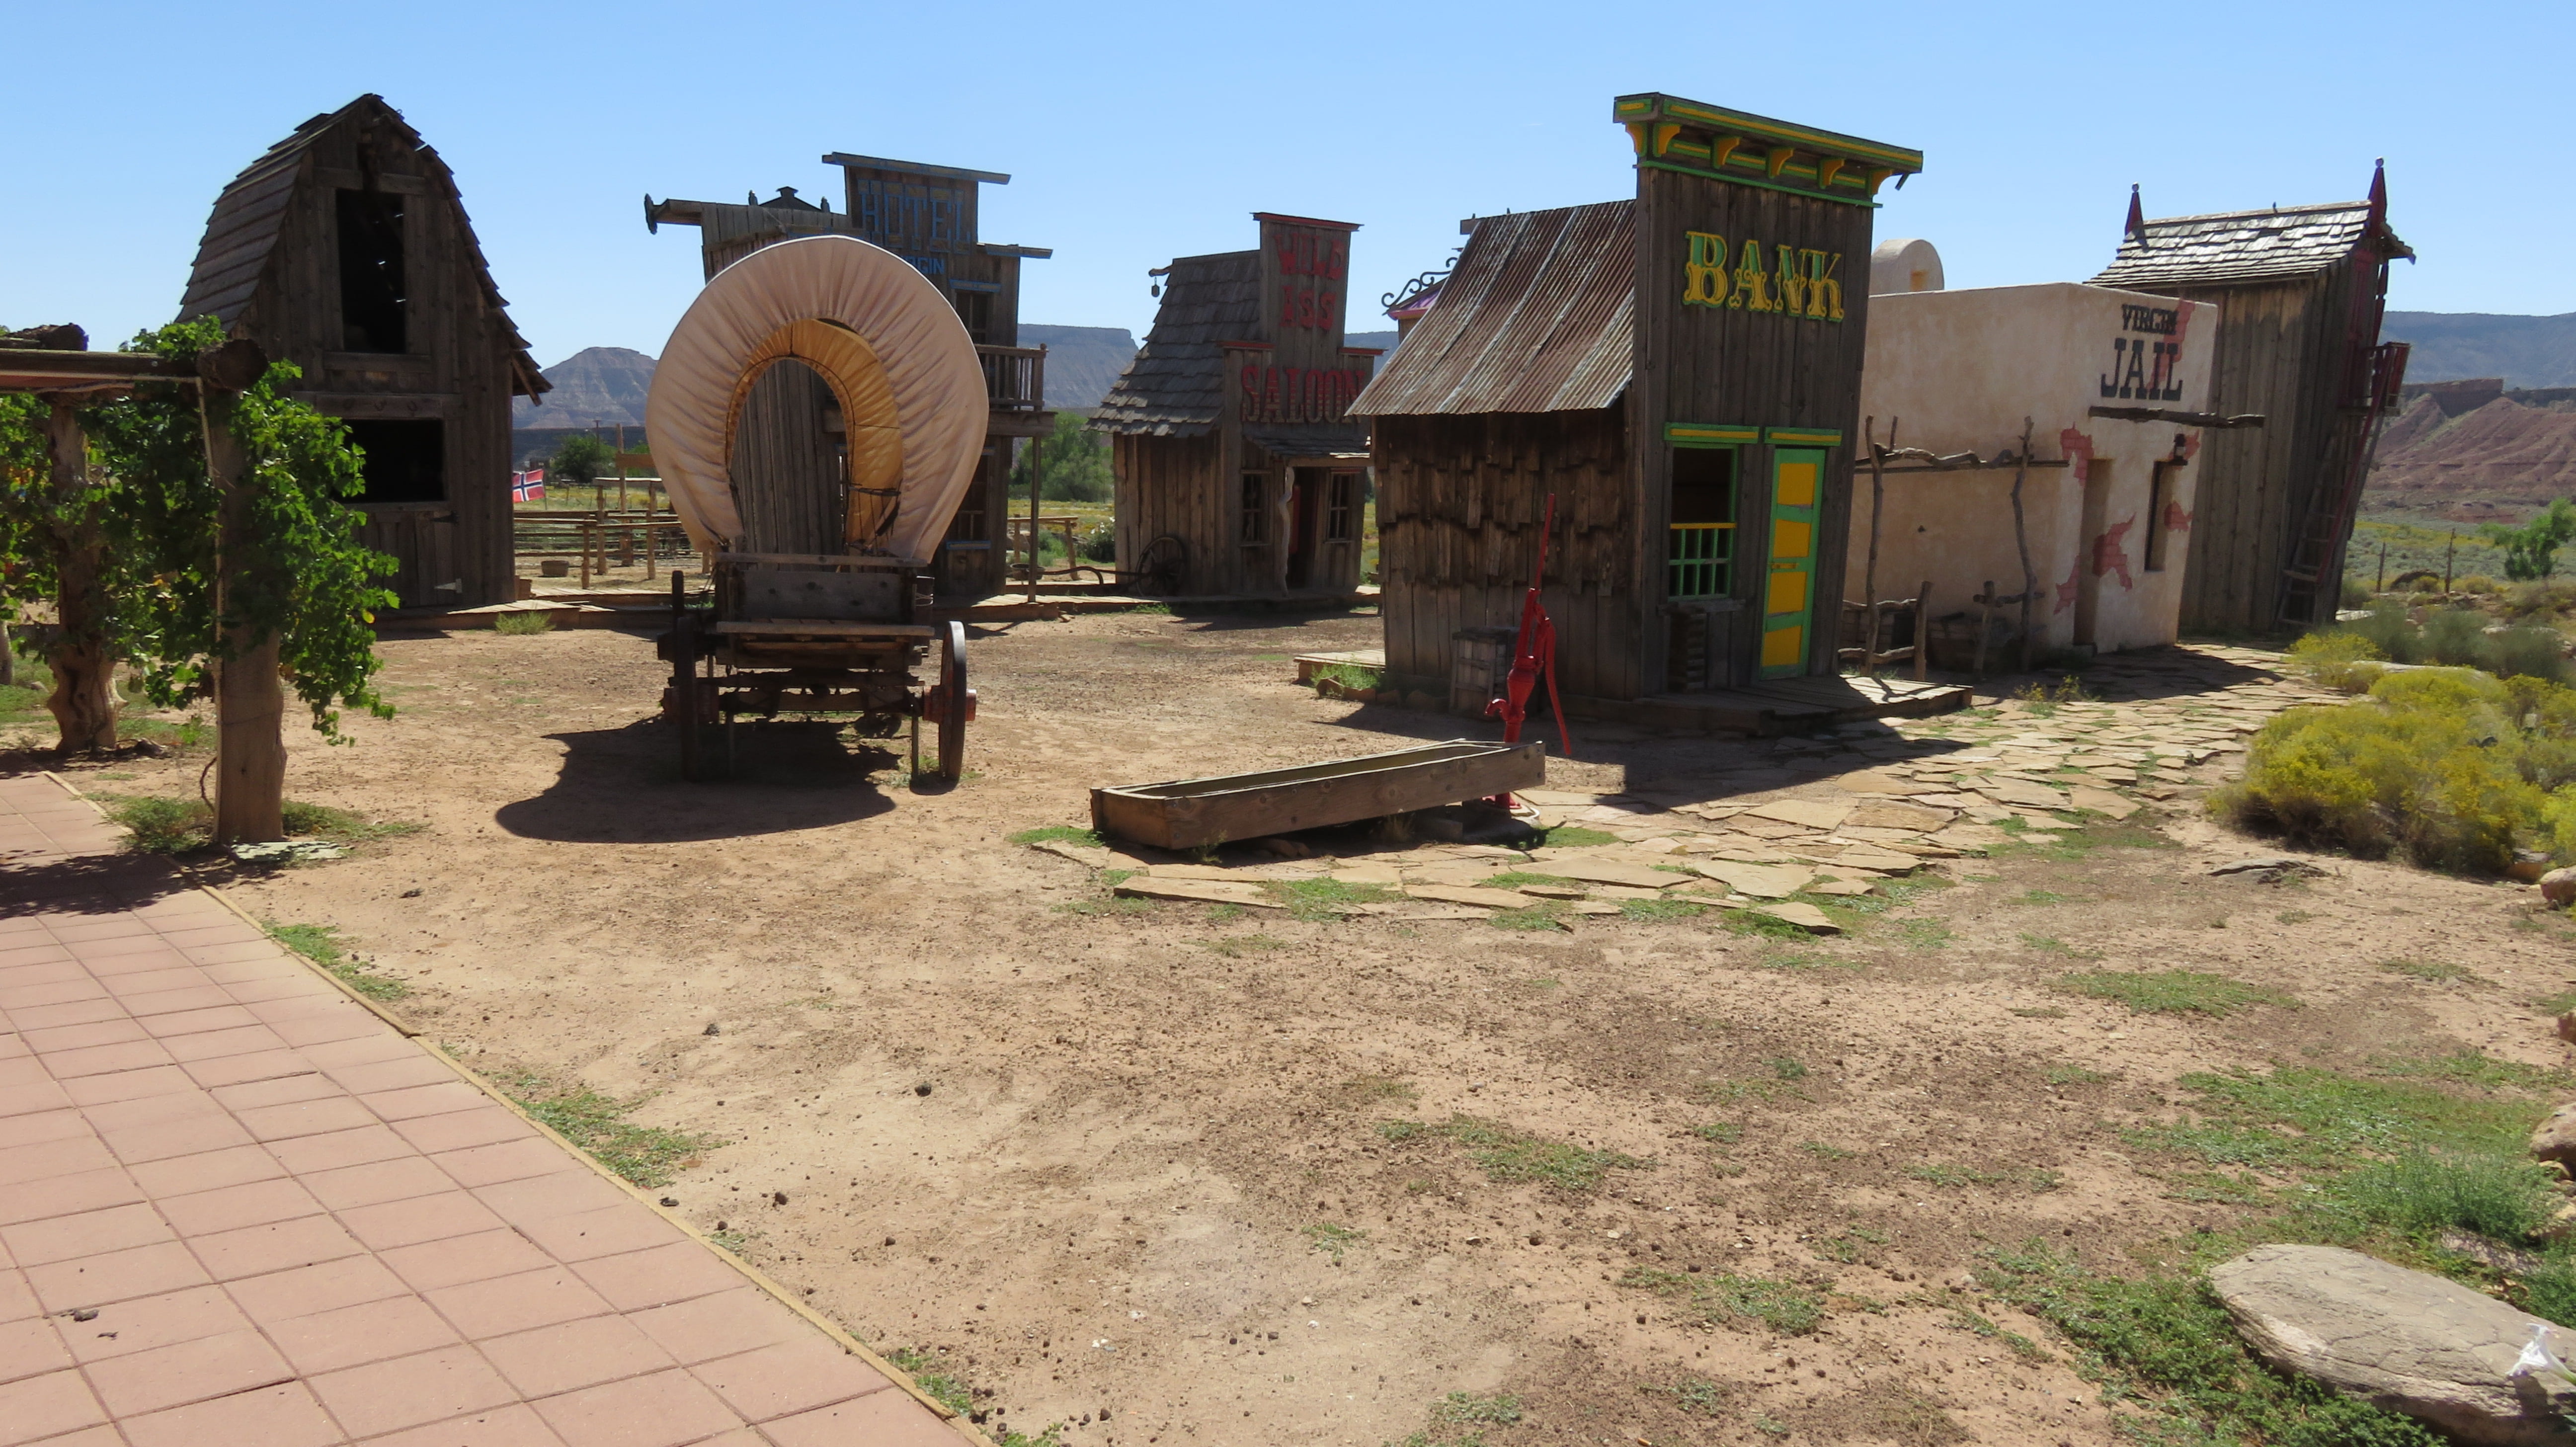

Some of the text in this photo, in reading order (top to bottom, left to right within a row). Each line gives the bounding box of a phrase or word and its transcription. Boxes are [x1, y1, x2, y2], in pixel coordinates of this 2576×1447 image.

[858, 179, 971, 255] HOTEL
[1273, 232, 1345, 281] WILD
[1682, 231, 1845, 322] BANK
[1279, 285, 1338, 332] ASS
[2121, 304, 2179, 335] VIRGIN
[1240, 365, 1366, 424] SALOON
[2100, 337, 2183, 402] JAIL
